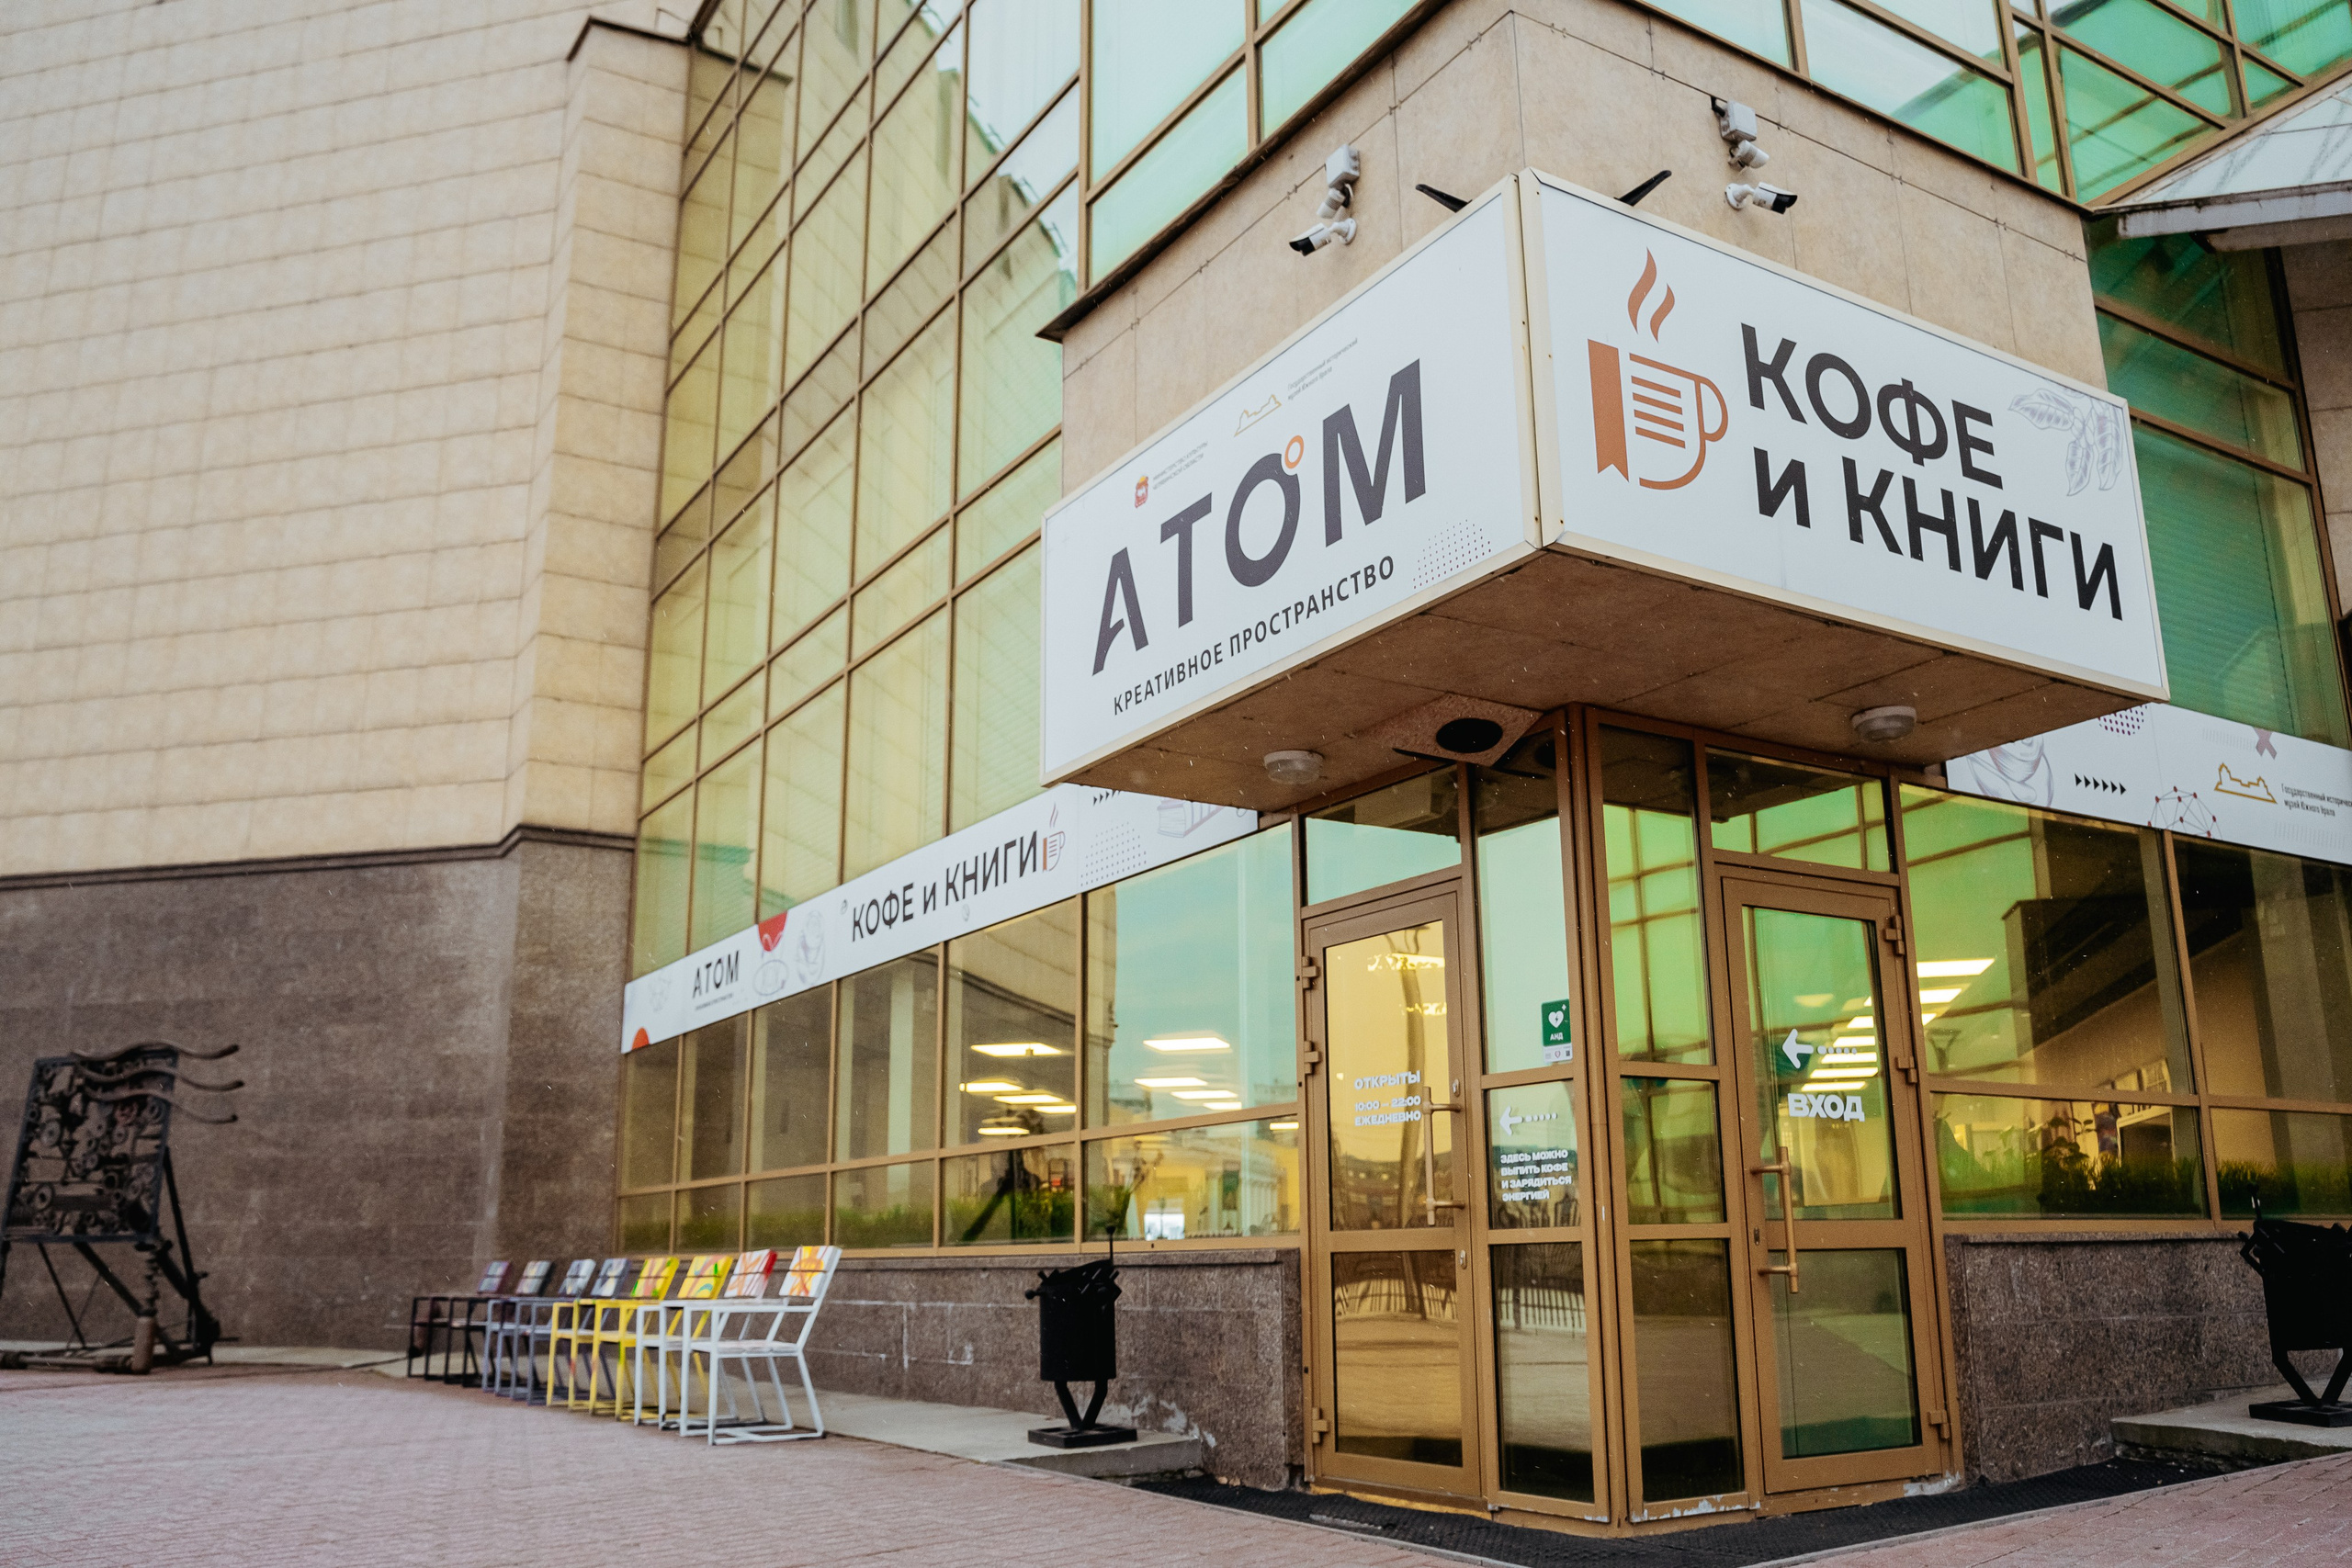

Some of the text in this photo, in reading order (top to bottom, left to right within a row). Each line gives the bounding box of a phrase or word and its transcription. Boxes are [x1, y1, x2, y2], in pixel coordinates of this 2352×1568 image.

[1740, 322, 2003, 490] КОФЕ
[1092, 358, 1426, 677] АТОМ
[1842, 457, 2122, 622] КНИГИ
[1114, 556, 1395, 716] КРЕАТИВНОЕ ПРОСТРАНСТВО
[853, 882, 914, 942] КОФЕ
[945, 829, 1037, 906] КНИГИ
[692, 950, 740, 999] АТОМ
[1353, 1070, 1421, 1090] ОТКРЫТЫ
[1355, 1100, 1381, 1112] 10:00
[1391, 1095, 1421, 1109] 22:00
[1787, 1093, 1865, 1122] ВХОД
[1354, 1110, 1422, 1127] ЕЖЕДНЕВНО
[1500, 1149, 1569, 1165] ЗДЕСЬ МОЖНО
[1500, 1162, 1569, 1177] ВЫПИТЬ КОФЕ
[1501, 1175, 1573, 1190] И ЗАРЯДИТЬСЯ
[1502, 1188, 1550, 1202] ЭНЕРГИЕЙ
